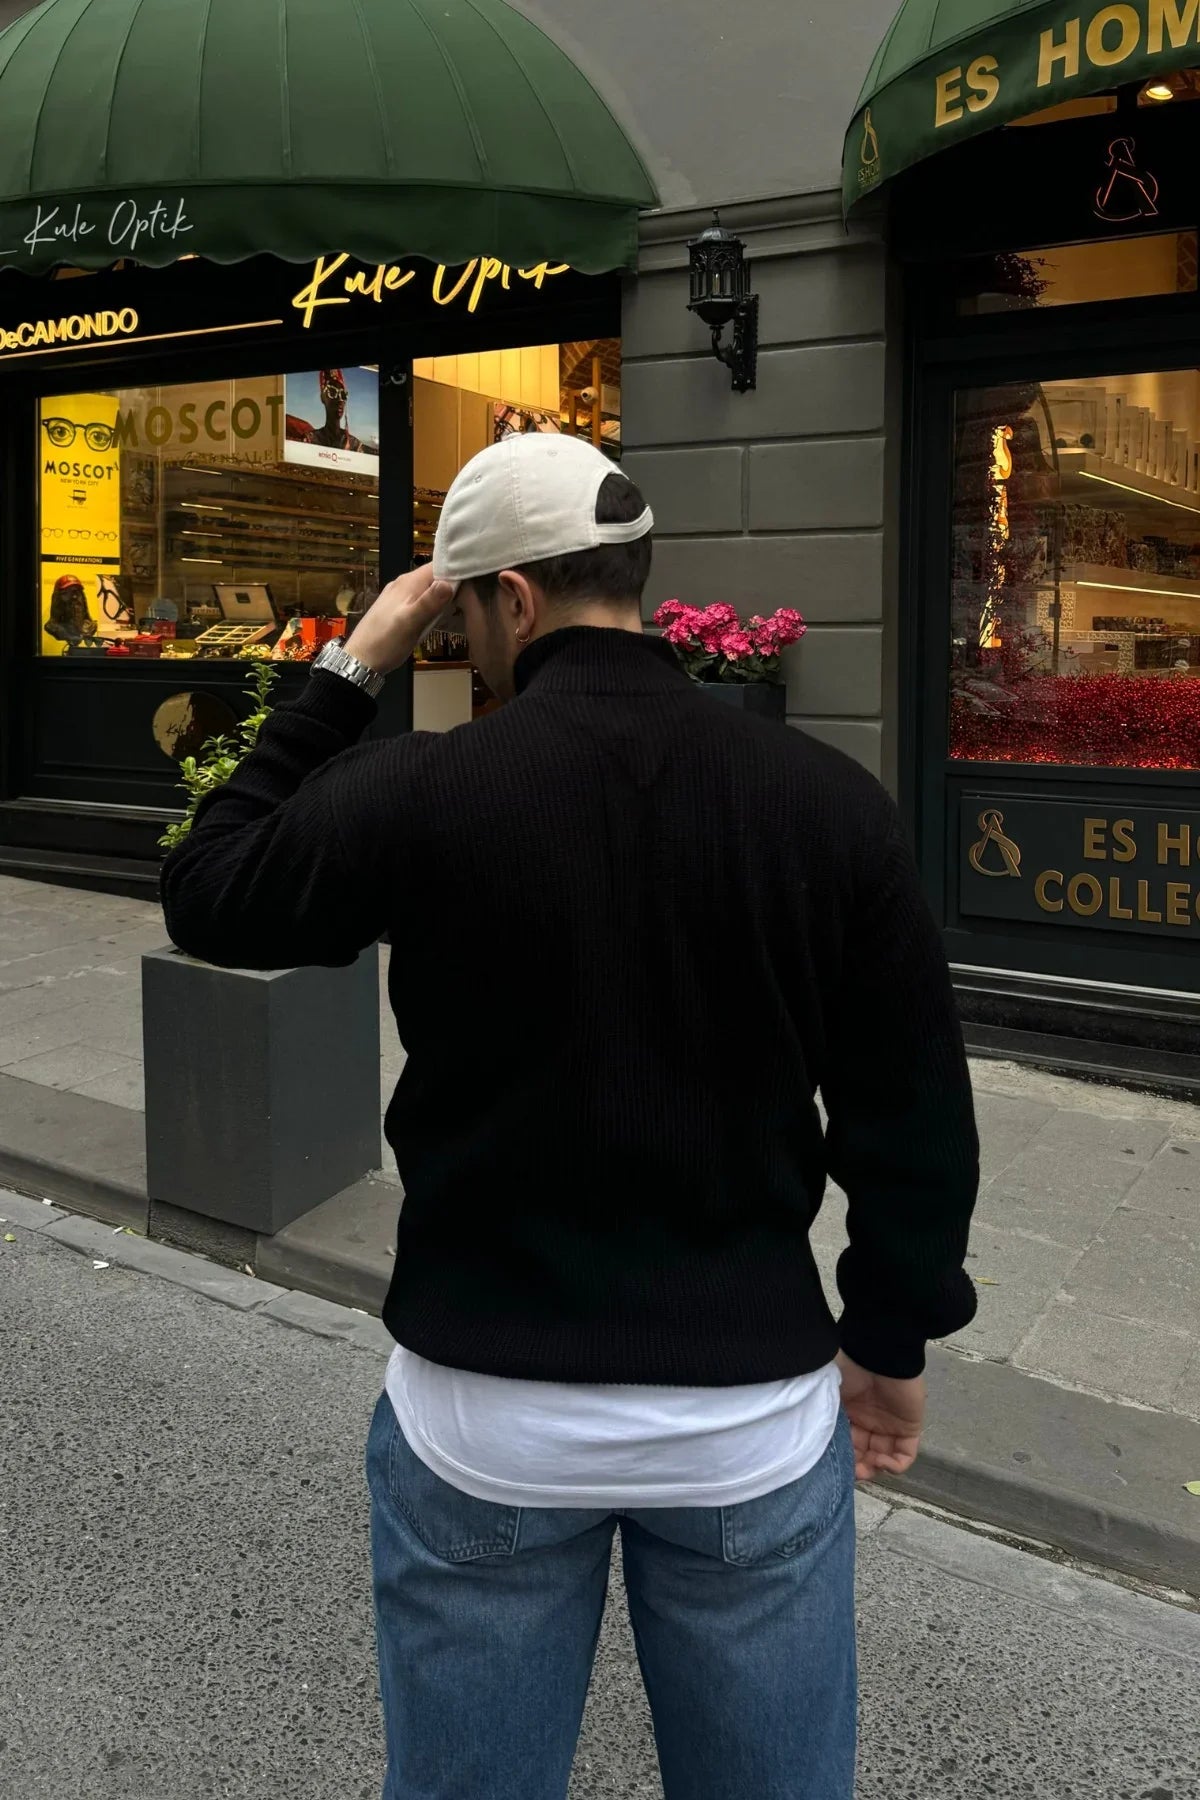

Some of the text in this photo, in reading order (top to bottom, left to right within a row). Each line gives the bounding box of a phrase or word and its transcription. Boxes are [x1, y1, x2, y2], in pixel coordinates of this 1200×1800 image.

[934, 54, 1000, 128] ES
[23, 197, 195, 256] Kule Optik
[111, 394, 284, 449] MOSCOT
[44, 459, 113, 481] MOSCOT
[1083, 816, 1200, 867] ES H
[1034, 868, 1200, 926] COLLE
